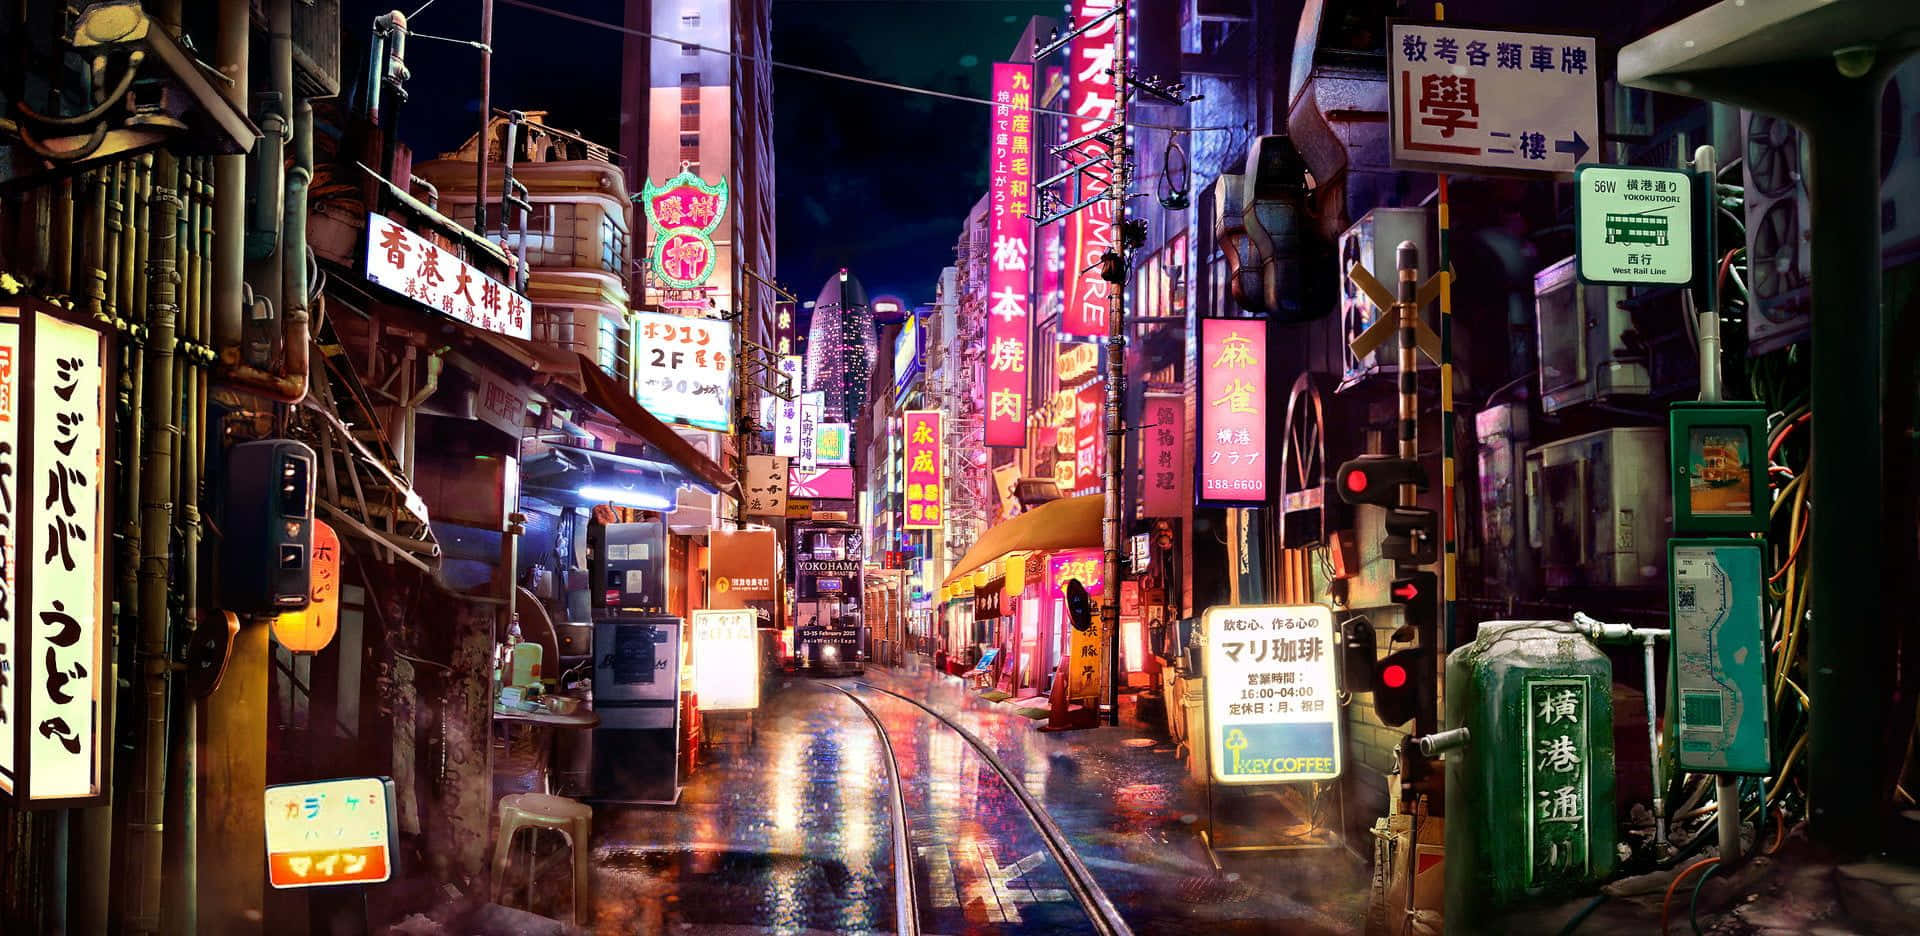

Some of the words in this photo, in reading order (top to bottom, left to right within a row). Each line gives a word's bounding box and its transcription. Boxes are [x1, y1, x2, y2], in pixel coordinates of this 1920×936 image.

[1419, 73, 1479, 138] 學
[1010, 71, 1030, 219] 九州産黒毛和牛
[1488, 131, 1547, 160] 二樓
[1594, 180, 1616, 193] 56W
[1623, 194, 1680, 203] YOKOKUTOORI
[665, 236, 706, 279] 押
[1628, 254, 1652, 265] 西行
[1612, 267, 1631, 275] West
[989, 235, 1028, 423] 松本焼肉
[650, 348, 685, 369] 2F
[695, 349, 727, 371] 屋台
[1211, 331, 1258, 415] 麻雀
[802, 412, 814, 460] 上野市場
[1210, 451, 1260, 466] クラブ
[767, 459, 782, 507] とんかつ
[1207, 479, 1263, 491] 188-6600
[799, 562, 859, 571] YOKOHAMA
[311, 543, 333, 628] ホッピー
[1223, 618, 1319, 632] 飲む心、作る心の
[1222, 637, 1324, 662] マリ珈琲
[1239, 759, 1272, 774] KEY
[1273, 757, 1332, 773] COFFEE
[288, 852, 367, 878] マイン
